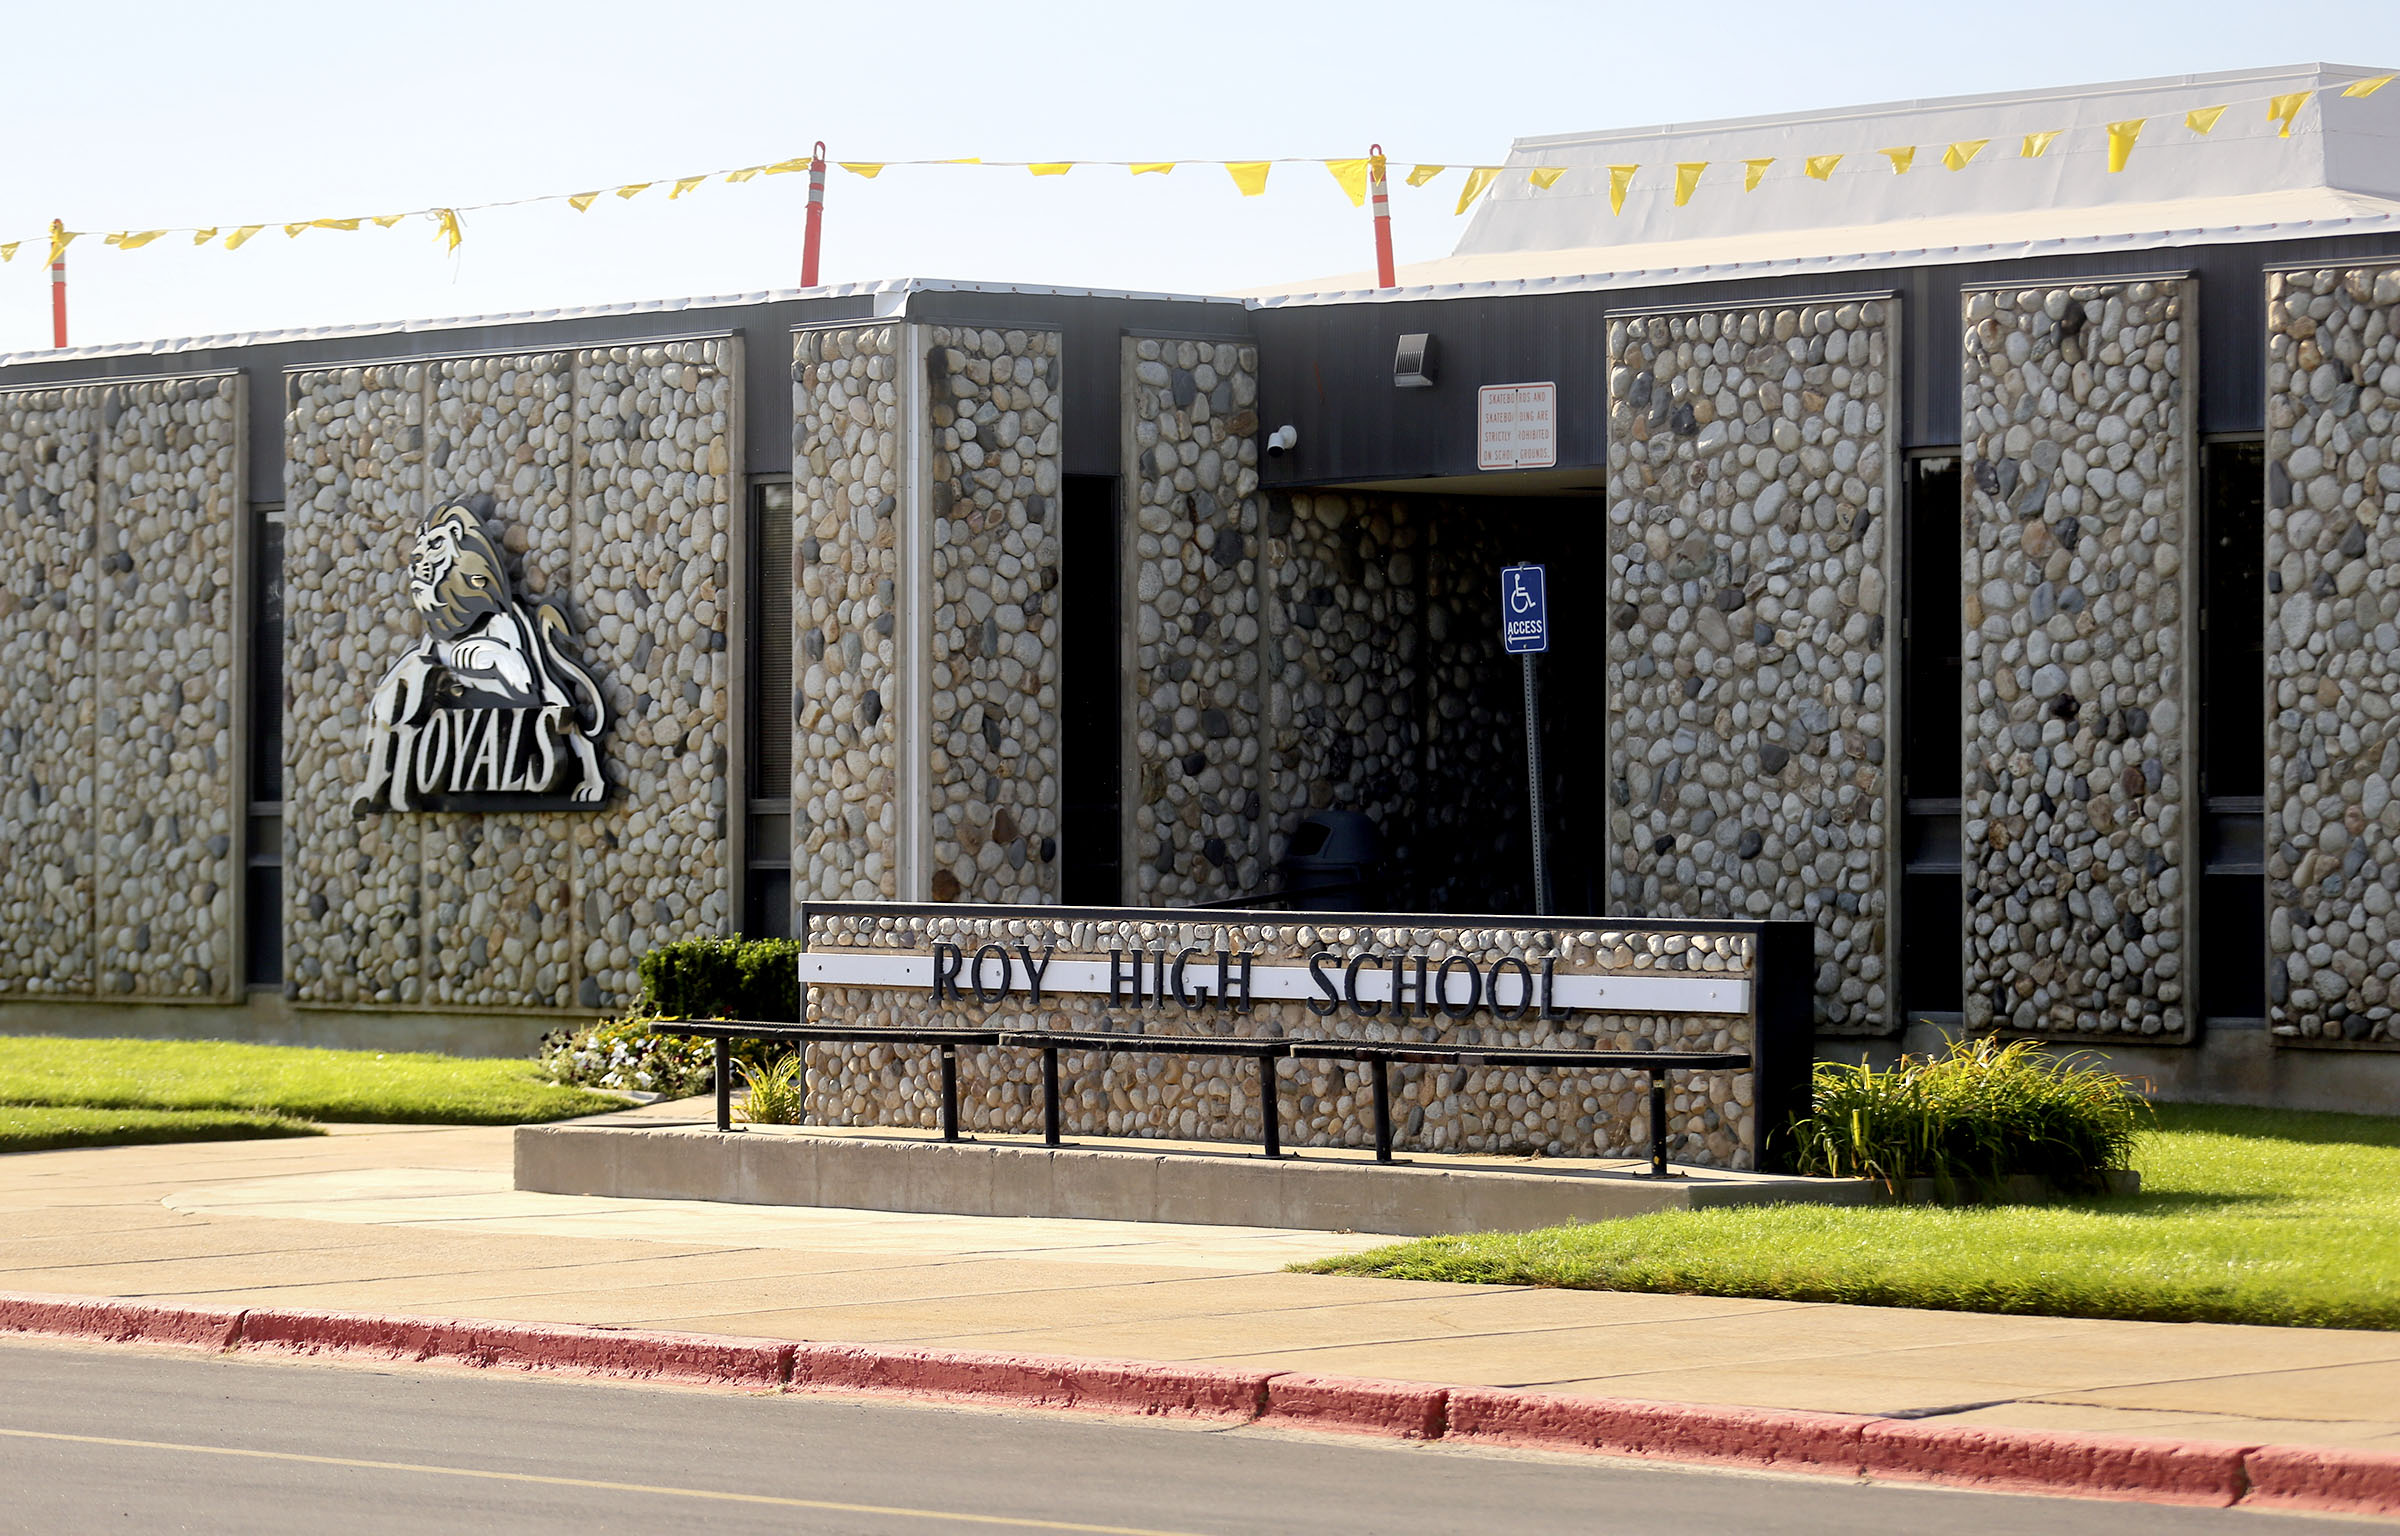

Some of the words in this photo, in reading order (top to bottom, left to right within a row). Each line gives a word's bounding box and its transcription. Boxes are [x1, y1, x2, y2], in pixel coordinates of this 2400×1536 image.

[1489, 392, 1531, 405] SKATEBORDS
[1533, 391, 1546, 402] AND
[1485, 411, 1535, 424] SKATEBODING
[1537, 410, 1549, 421] ARE
[1485, 431, 1511, 442] STRICTLY
[1518, 429, 1549, 441] OHIBITED
[1484, 450, 1492, 461] ON
[1495, 449, 1513, 461] SCHO
[1507, 620, 1543, 635] ACCESS
[352, 658, 562, 812] ROYALS
[929, 941, 1054, 1005] ROY
[1108, 947, 1253, 1012] HIGH
[1306, 951, 1575, 1021] SCHOOL
